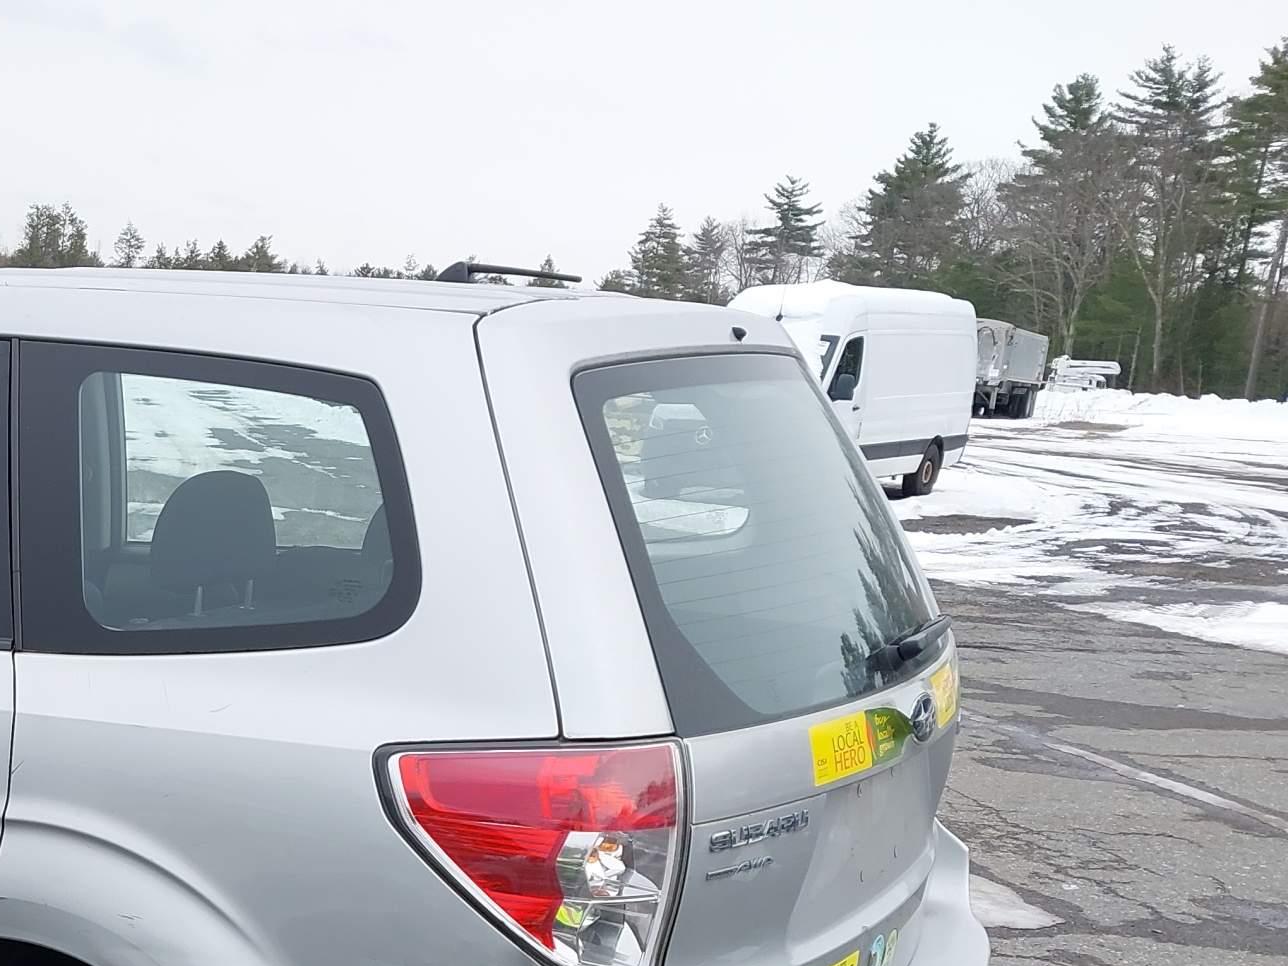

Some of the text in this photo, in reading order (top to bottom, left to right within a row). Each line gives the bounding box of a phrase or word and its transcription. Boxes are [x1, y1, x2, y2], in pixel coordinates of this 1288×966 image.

[831, 728, 864, 753] LOCAL
[834, 746, 866, 773] HERO
[709, 809, 808, 852] SUBARU
